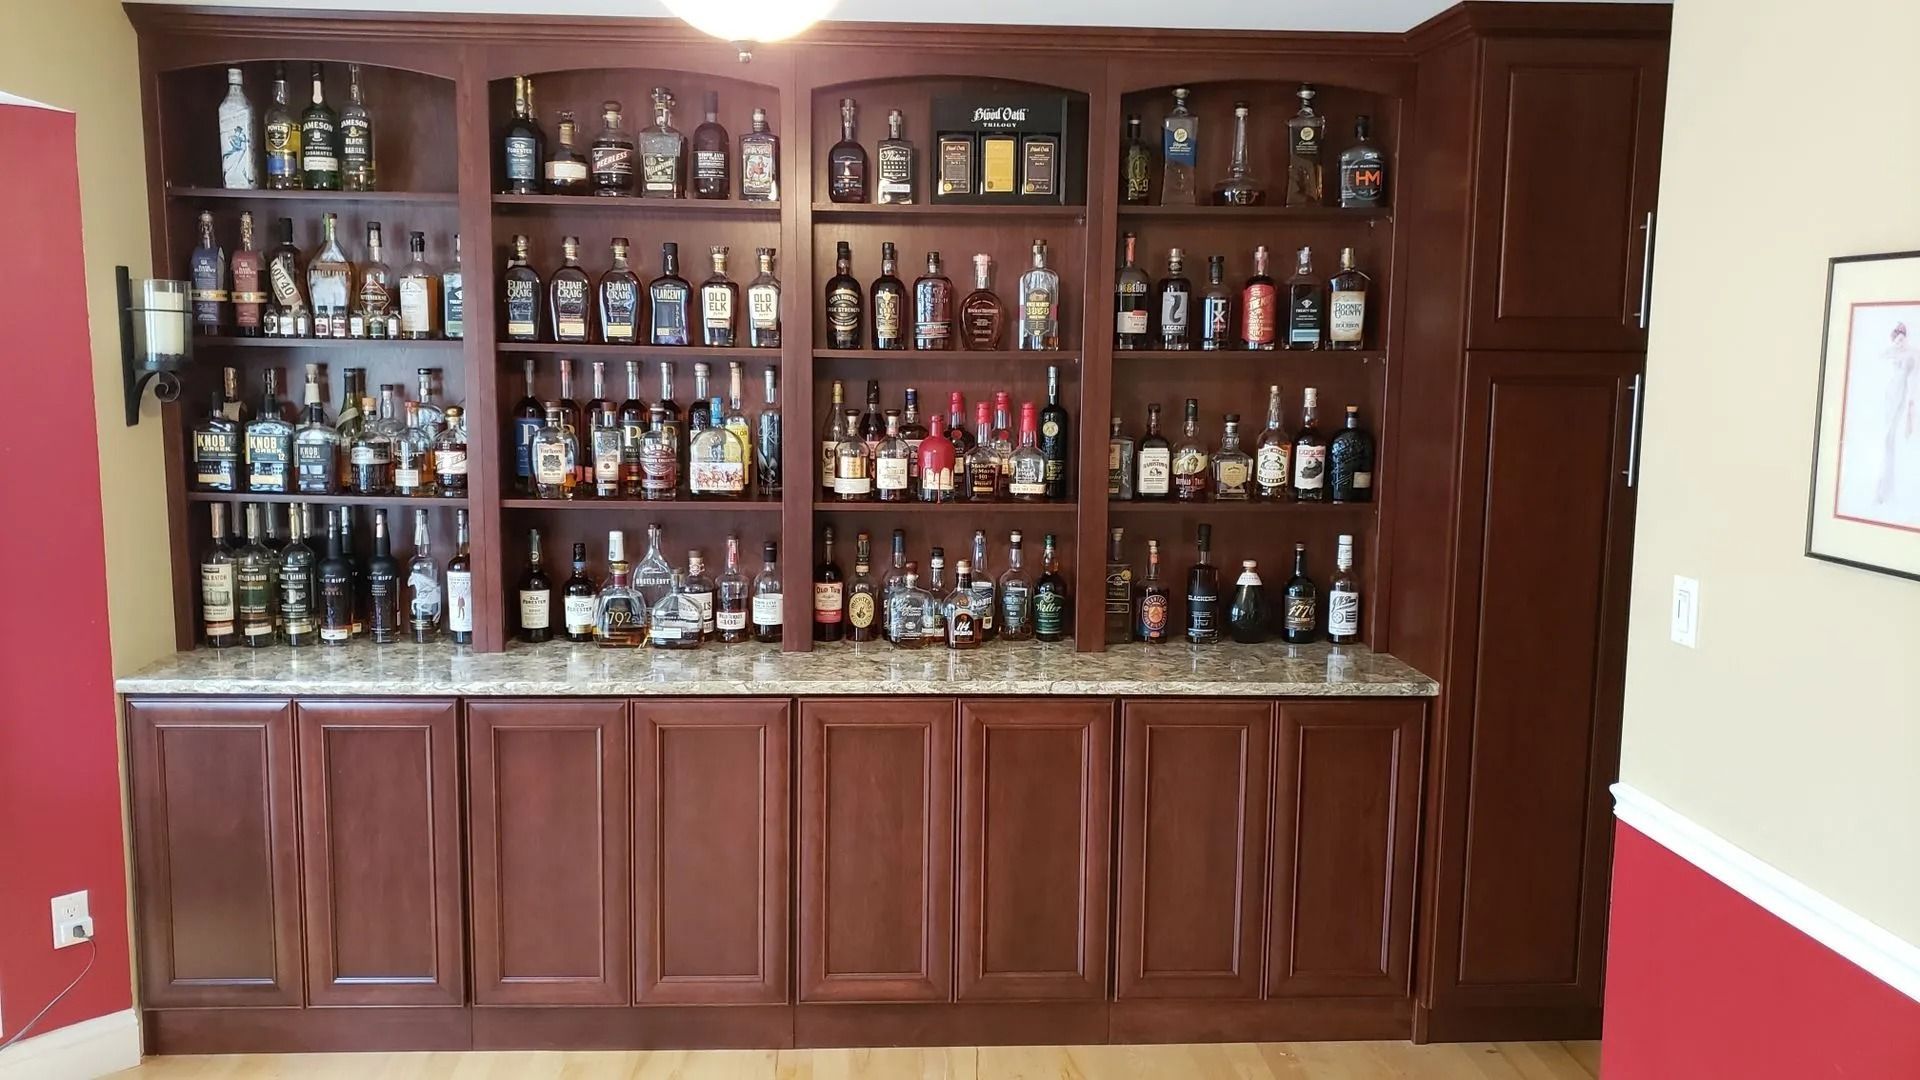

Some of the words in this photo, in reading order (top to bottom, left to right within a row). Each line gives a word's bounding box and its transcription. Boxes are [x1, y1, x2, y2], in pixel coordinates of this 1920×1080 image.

[971, 107, 1001, 122] Blood
[1000, 107, 1028, 121] Oath
[303, 121, 334, 133] JAMESON
[341, 119, 368, 129] JAMESON
[597, 151, 628, 169] PEERLESS
[1355, 170, 1381, 186] HM
[271, 261, 286, 283] LOT
[280, 281, 295, 296] 40
[507, 280, 532, 290] ELIJAH
[558, 280, 582, 290] ELIJAH
[607, 282, 631, 291] ELIJAH
[507, 288, 532, 299] CRAIG
[558, 288, 582, 298] CRAIG
[606, 290, 631, 300] CRAIG
[657, 289, 681, 300] LARCENY
[709, 292, 727, 302] OLD
[754, 293, 772, 303] OLD
[709, 302, 727, 312] ELK
[754, 303, 772, 313] ELK
[1335, 310, 1361, 319] COUNTY
[197, 435, 226, 447] KNOB
[624, 425, 641, 447] P
[250, 437, 277, 449] KNOB
[300, 447, 318, 455] KNOB
[1176, 477, 1191, 485] BUFFALO
[830, 586, 841, 594] TUB
[1036, 599, 1061, 613] Weller
[1287, 604, 1315, 618] 1776
[956, 621, 970, 631] 114
